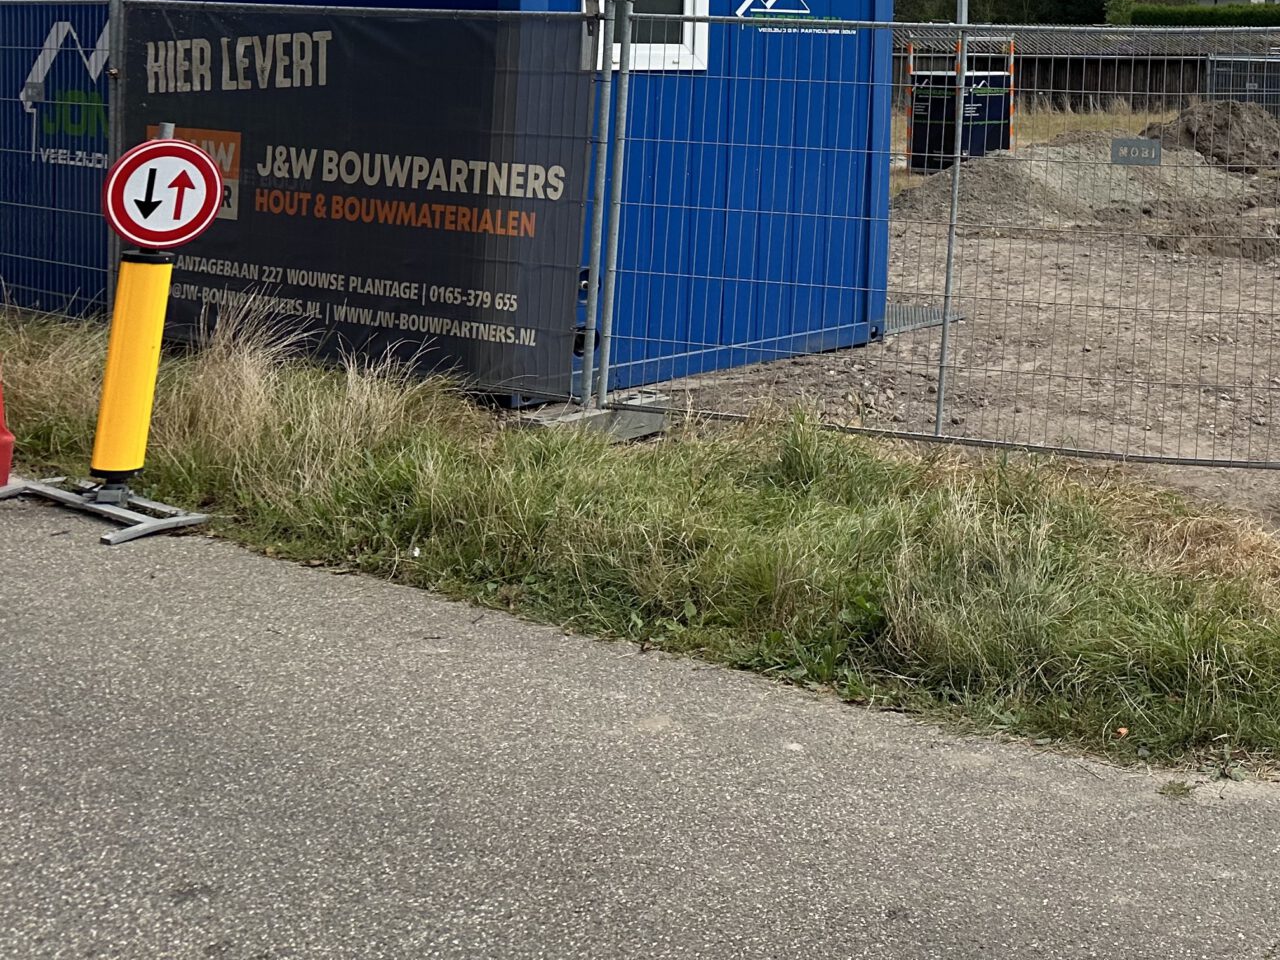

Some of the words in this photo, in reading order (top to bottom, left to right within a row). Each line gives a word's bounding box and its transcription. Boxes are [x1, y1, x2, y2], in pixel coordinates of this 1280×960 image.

[146, 38, 212, 94] HIER
[220, 30, 332, 91] LEVERT
[256, 144, 318, 181] J&W
[321, 148, 566, 201] BOUWPARTNERS
[255, 188, 312, 216] HOUT
[313, 194, 327, 219] &
[330, 195, 536, 238] BOUWMATERIALEN
[173, 254, 259, 281] ANTAGEBAAN
[262, 265, 283, 283] 227
[286, 268, 345, 291] WOUWSE
[349, 275, 419, 300] PLANTAGE
[430, 285, 492, 308] 0165-379
[494, 292, 518, 312] 655
[333, 304, 536, 347] WWW.JW-BOUWPARTNERS.NL
